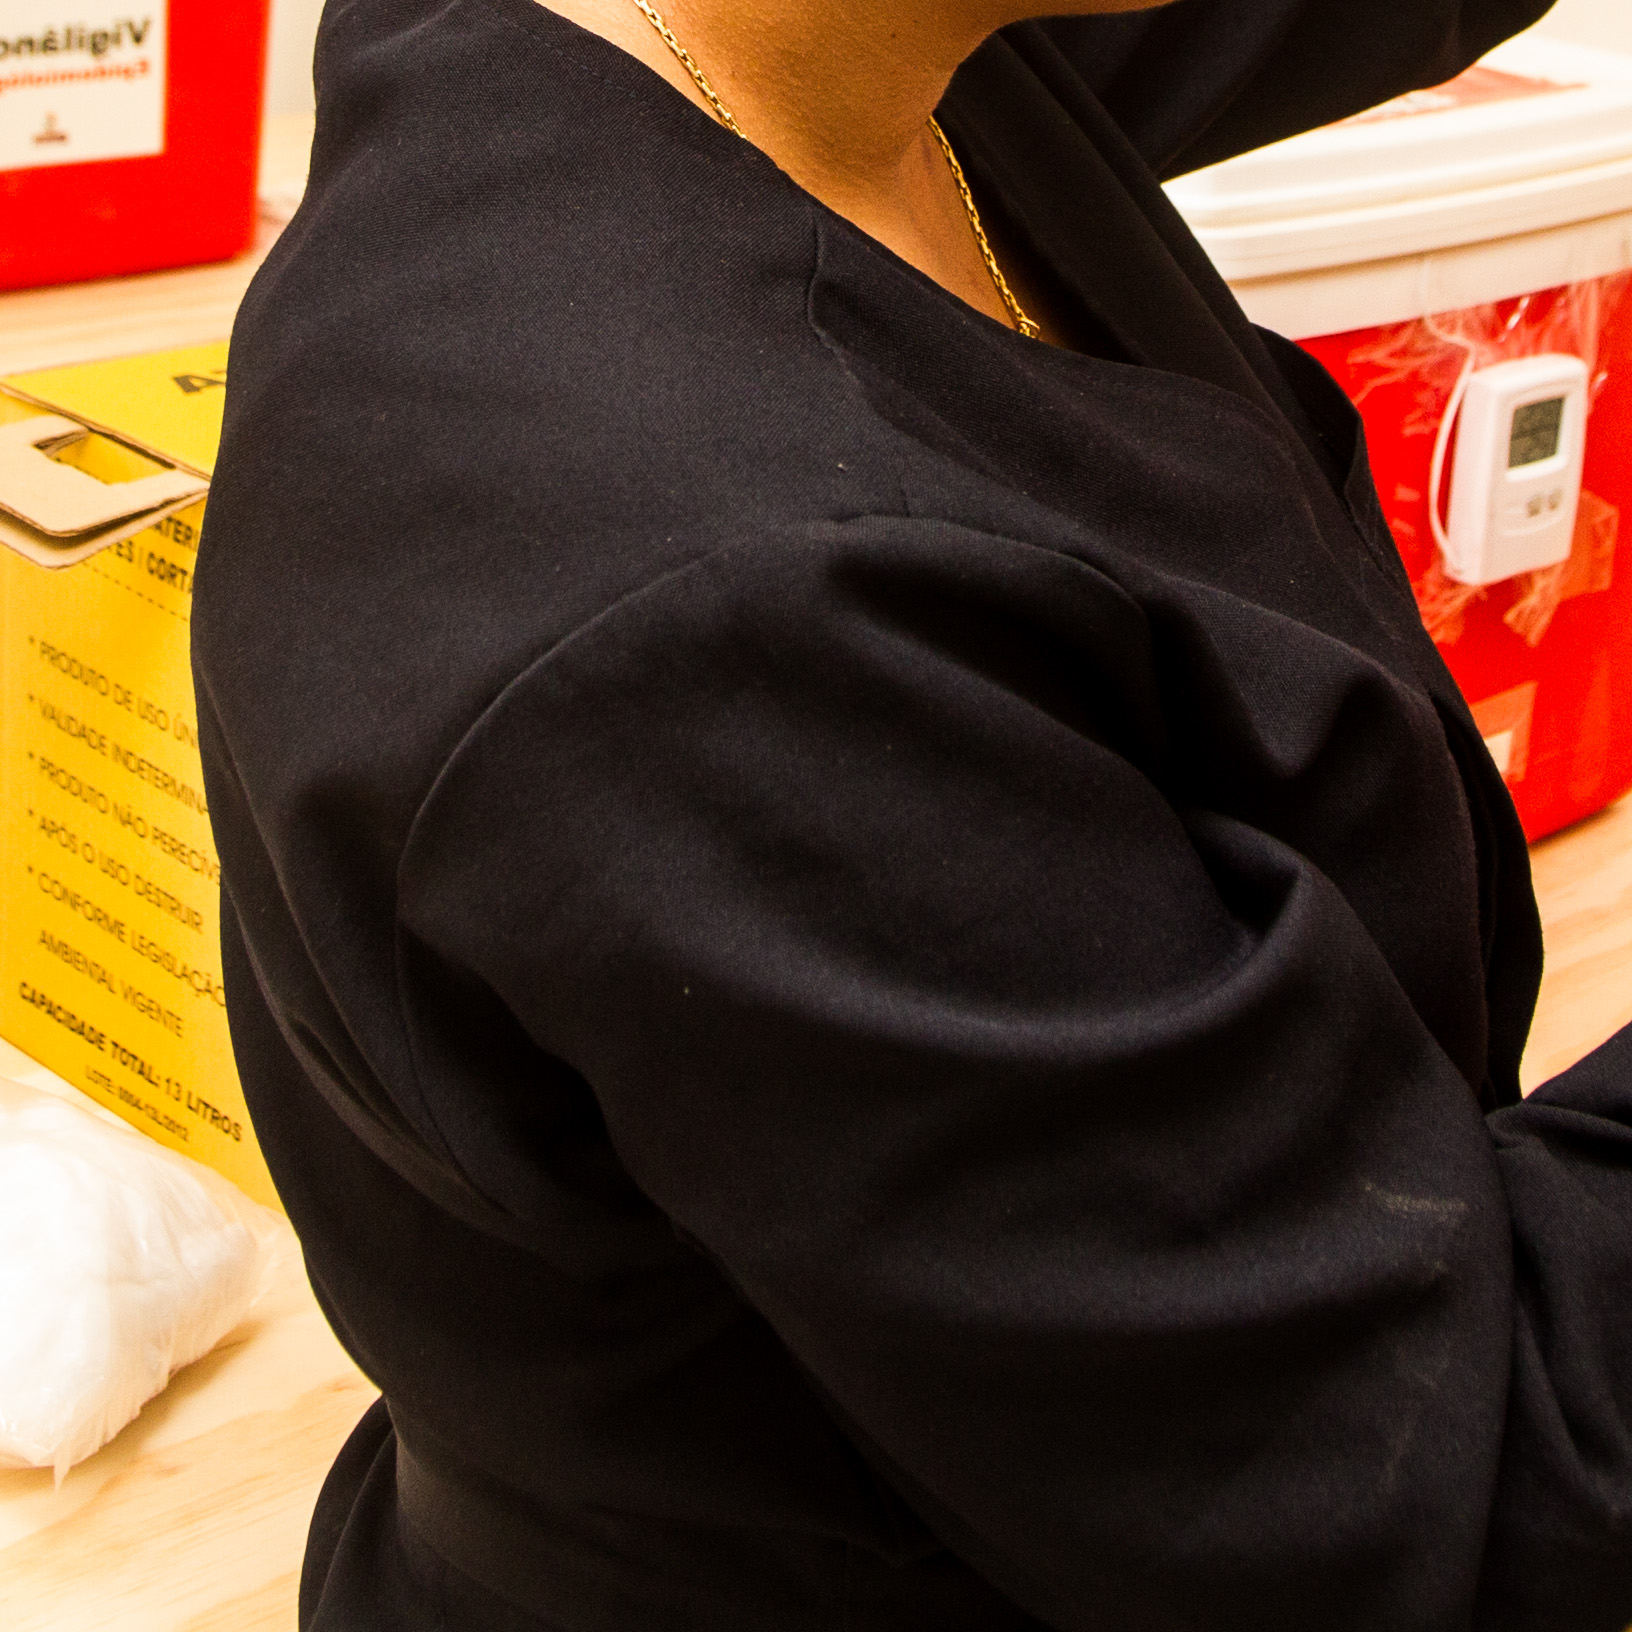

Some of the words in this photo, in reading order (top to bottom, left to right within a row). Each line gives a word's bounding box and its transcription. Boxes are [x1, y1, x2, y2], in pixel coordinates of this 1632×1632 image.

[39, 640, 111, 698] PRODUTO
[113, 683, 134, 712] DE
[137, 696, 169, 732] USO
[39, 697, 108, 757] VALIDADE
[39, 756, 109, 815] PRODUTO
[113, 802, 148, 839] NÃO
[38, 816, 79, 856] APÓS
[82, 842, 97, 864] O
[99, 850, 130, 886] USO
[134, 873, 204, 934] DESTRUIR
[38, 872, 127, 944] CONFORME
[38, 929, 117, 995] AMBIENTAL
[120, 980, 184, 1039] VIGENTE
[19, 981, 106, 1053] CAPACIDADE
[111, 1039, 161, 1089] TOTAL:
[165, 1077, 184, 1103] 13
[186, 1090, 244, 1143] LITROS
